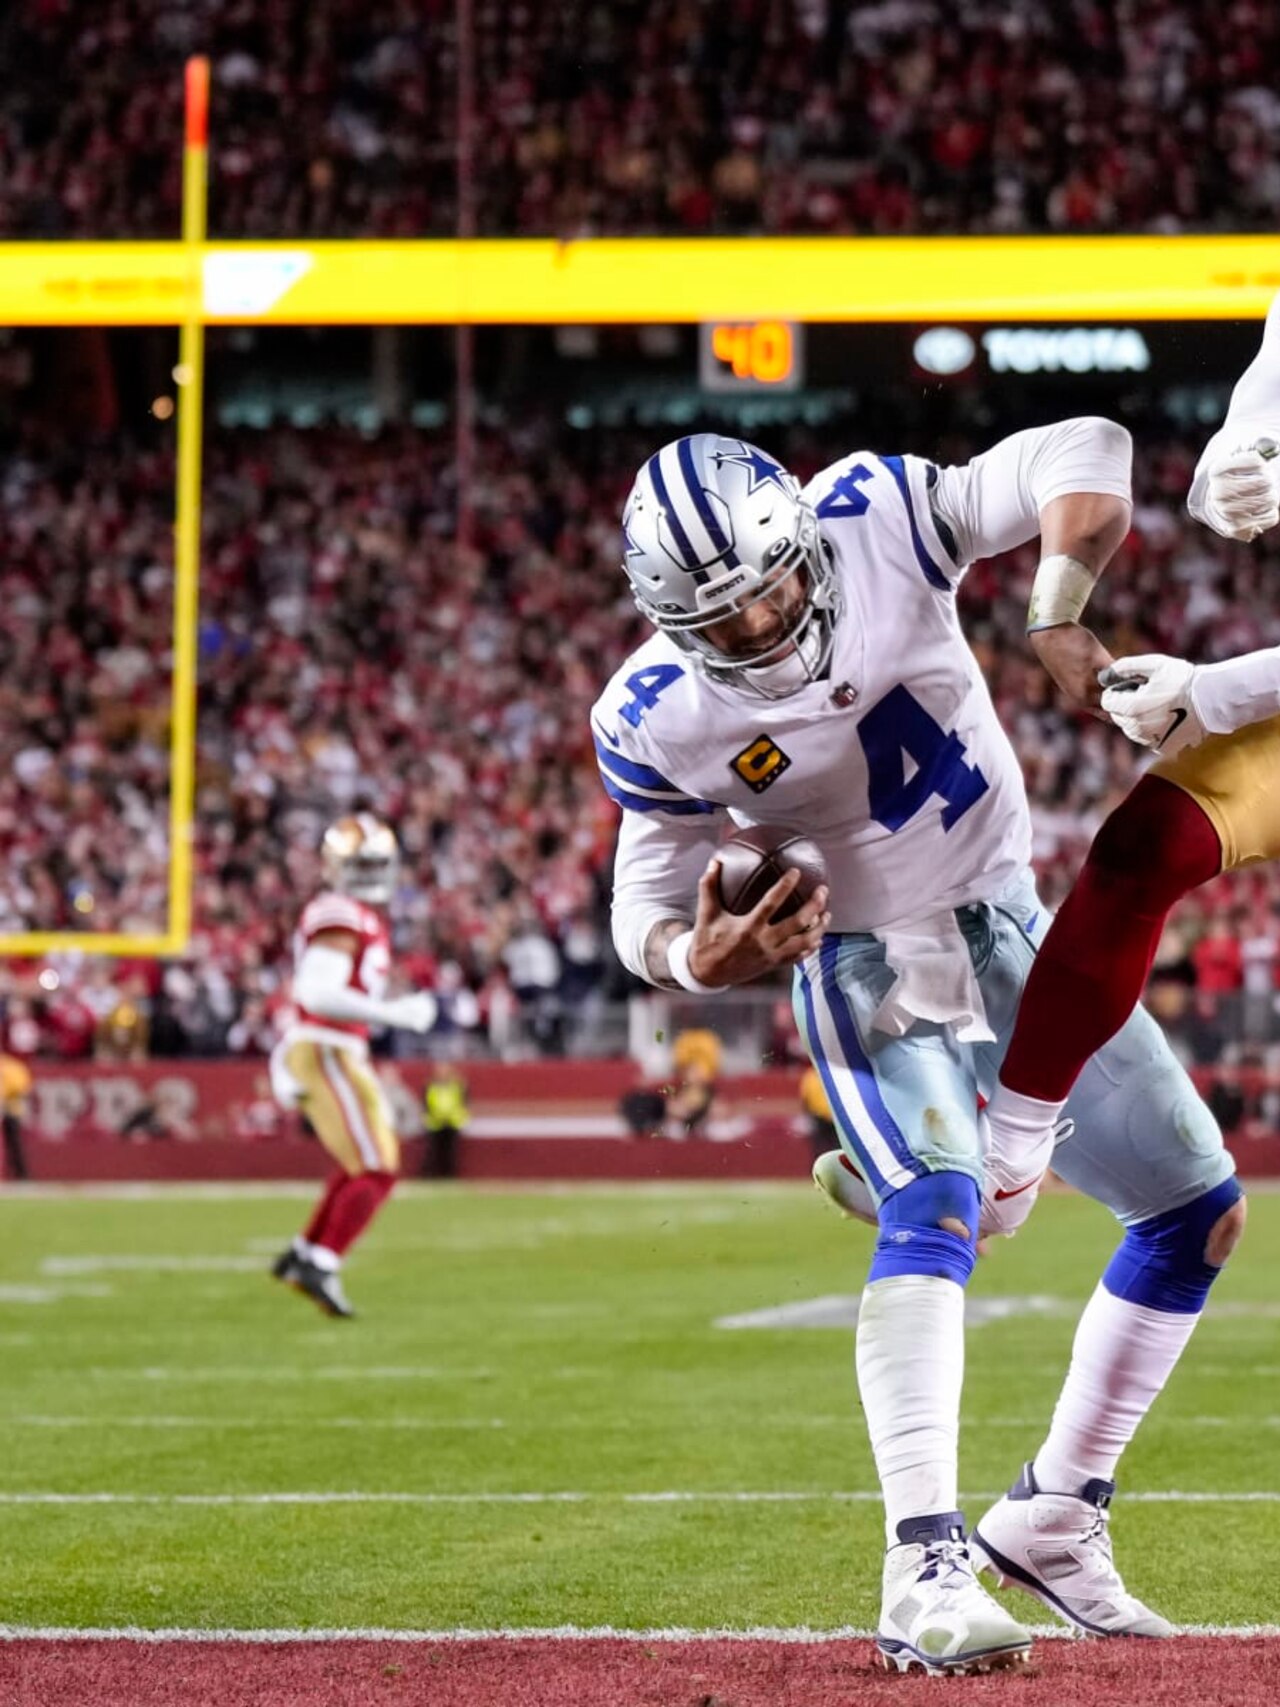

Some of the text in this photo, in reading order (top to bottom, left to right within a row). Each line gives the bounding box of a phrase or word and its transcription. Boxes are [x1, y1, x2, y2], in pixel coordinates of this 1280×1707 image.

[712, 323, 792, 382] 40
[982, 328, 1150, 373] TOYOTA
[816, 463, 875, 519] 4
[618, 664, 685, 728] 4
[736, 740, 781, 782] C
[856, 682, 989, 834] 4
